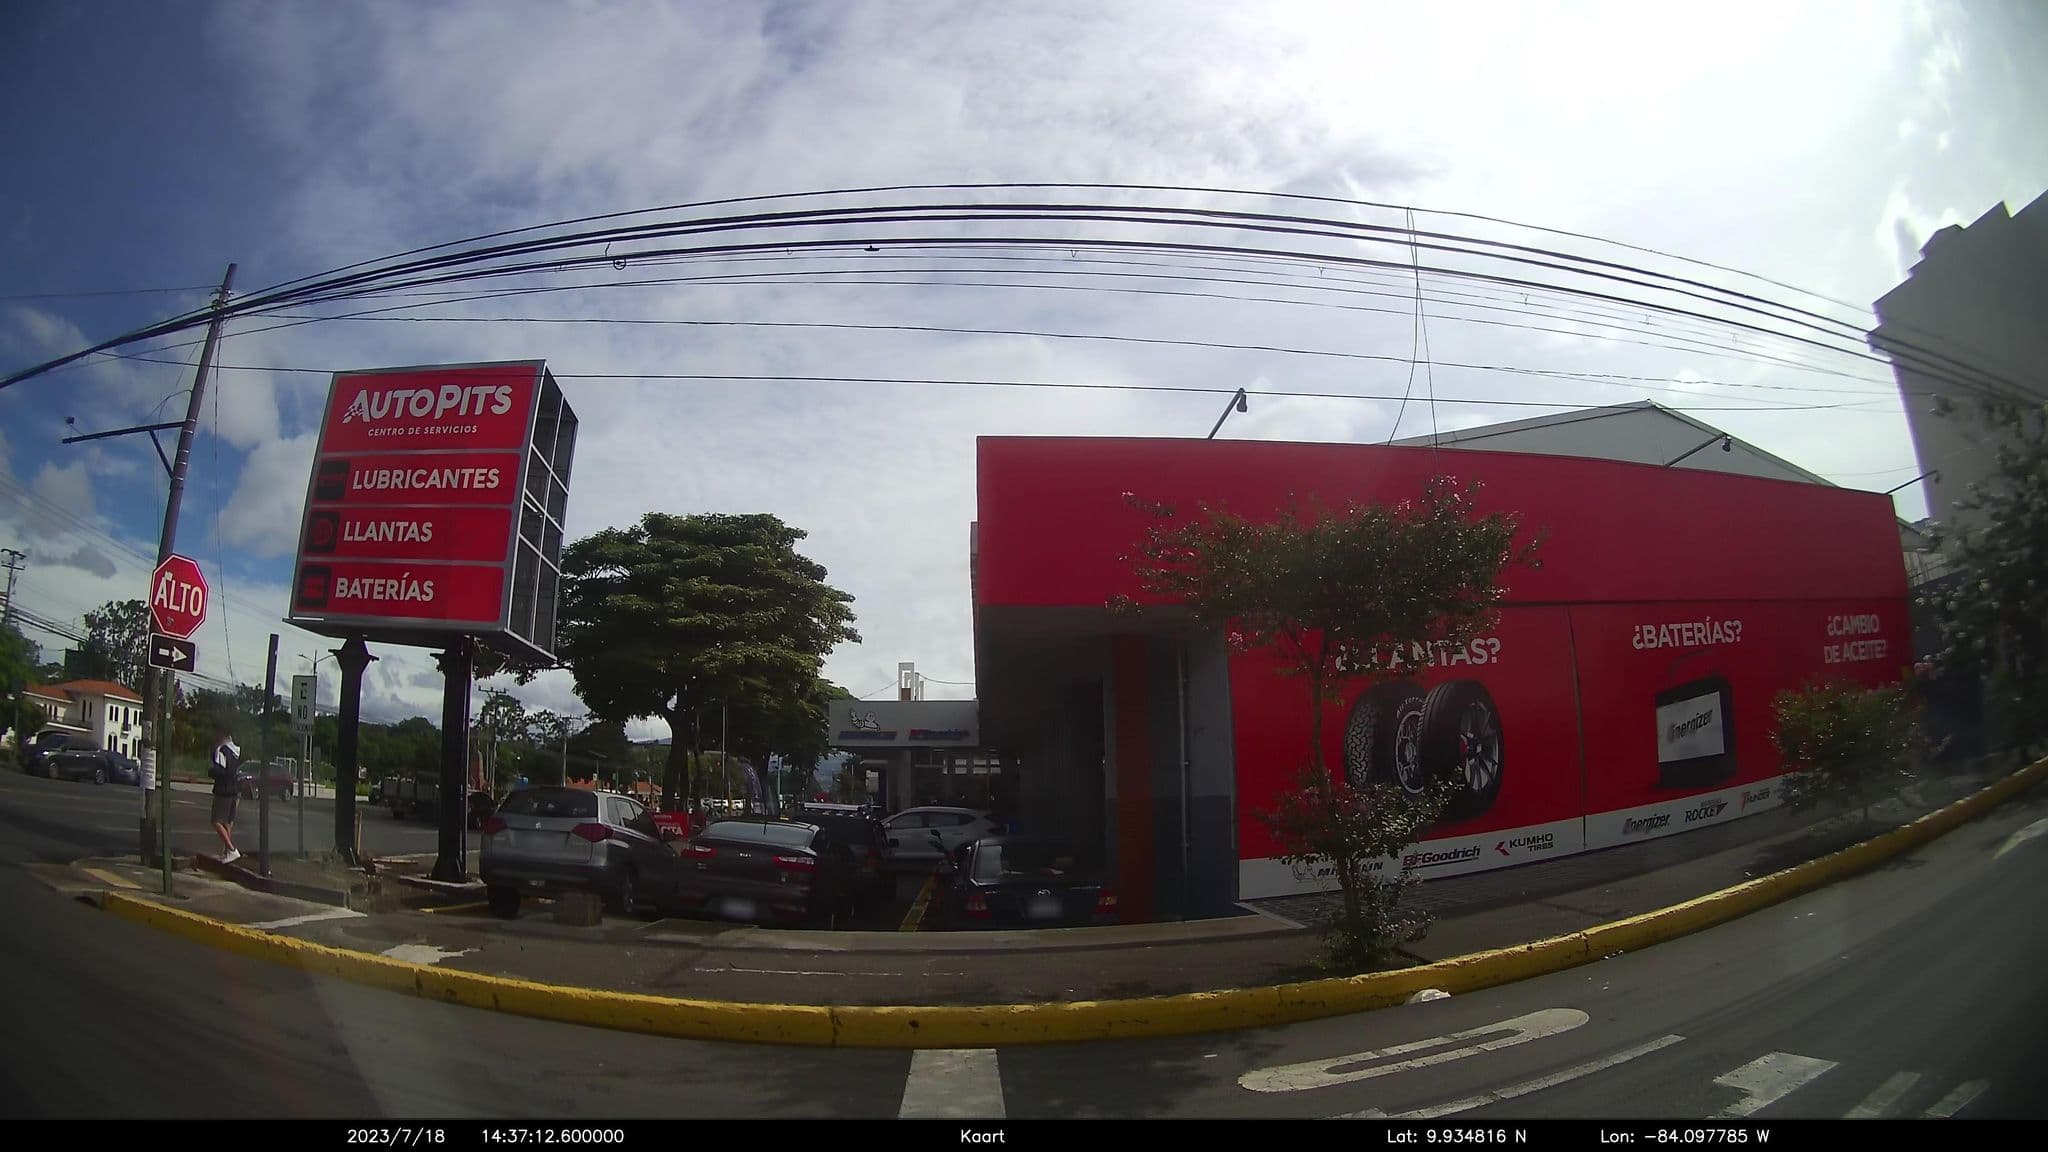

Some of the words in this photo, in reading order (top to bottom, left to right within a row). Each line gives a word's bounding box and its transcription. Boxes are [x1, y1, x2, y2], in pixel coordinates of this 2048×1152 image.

[367, 427, 405, 437] CENTRO
[407, 426, 421, 435] DE
[423, 424, 478, 435] SERVICIOS
[352, 467, 500, 490] LUBRICANTES
[343, 520, 433, 542] LLANTAS
[153, 573, 203, 617] ALTO
[335, 571, 434, 602] BATERÍAS
[1632, 616, 1742, 650] ¿BATERÍAS?
[1826, 613, 1880, 637] ¿CAMBIO
[1824, 645, 1840, 664] DE
[1842, 639, 1887, 662] ACEITE?
[298, 704, 308, 720] NO
[1668, 708, 1714, 744] Energizer
[1508, 833, 1554, 849] KUMHO
[1527, 842, 1554, 853] TIRES
[1402, 845, 1480, 867] BFGoodrich
